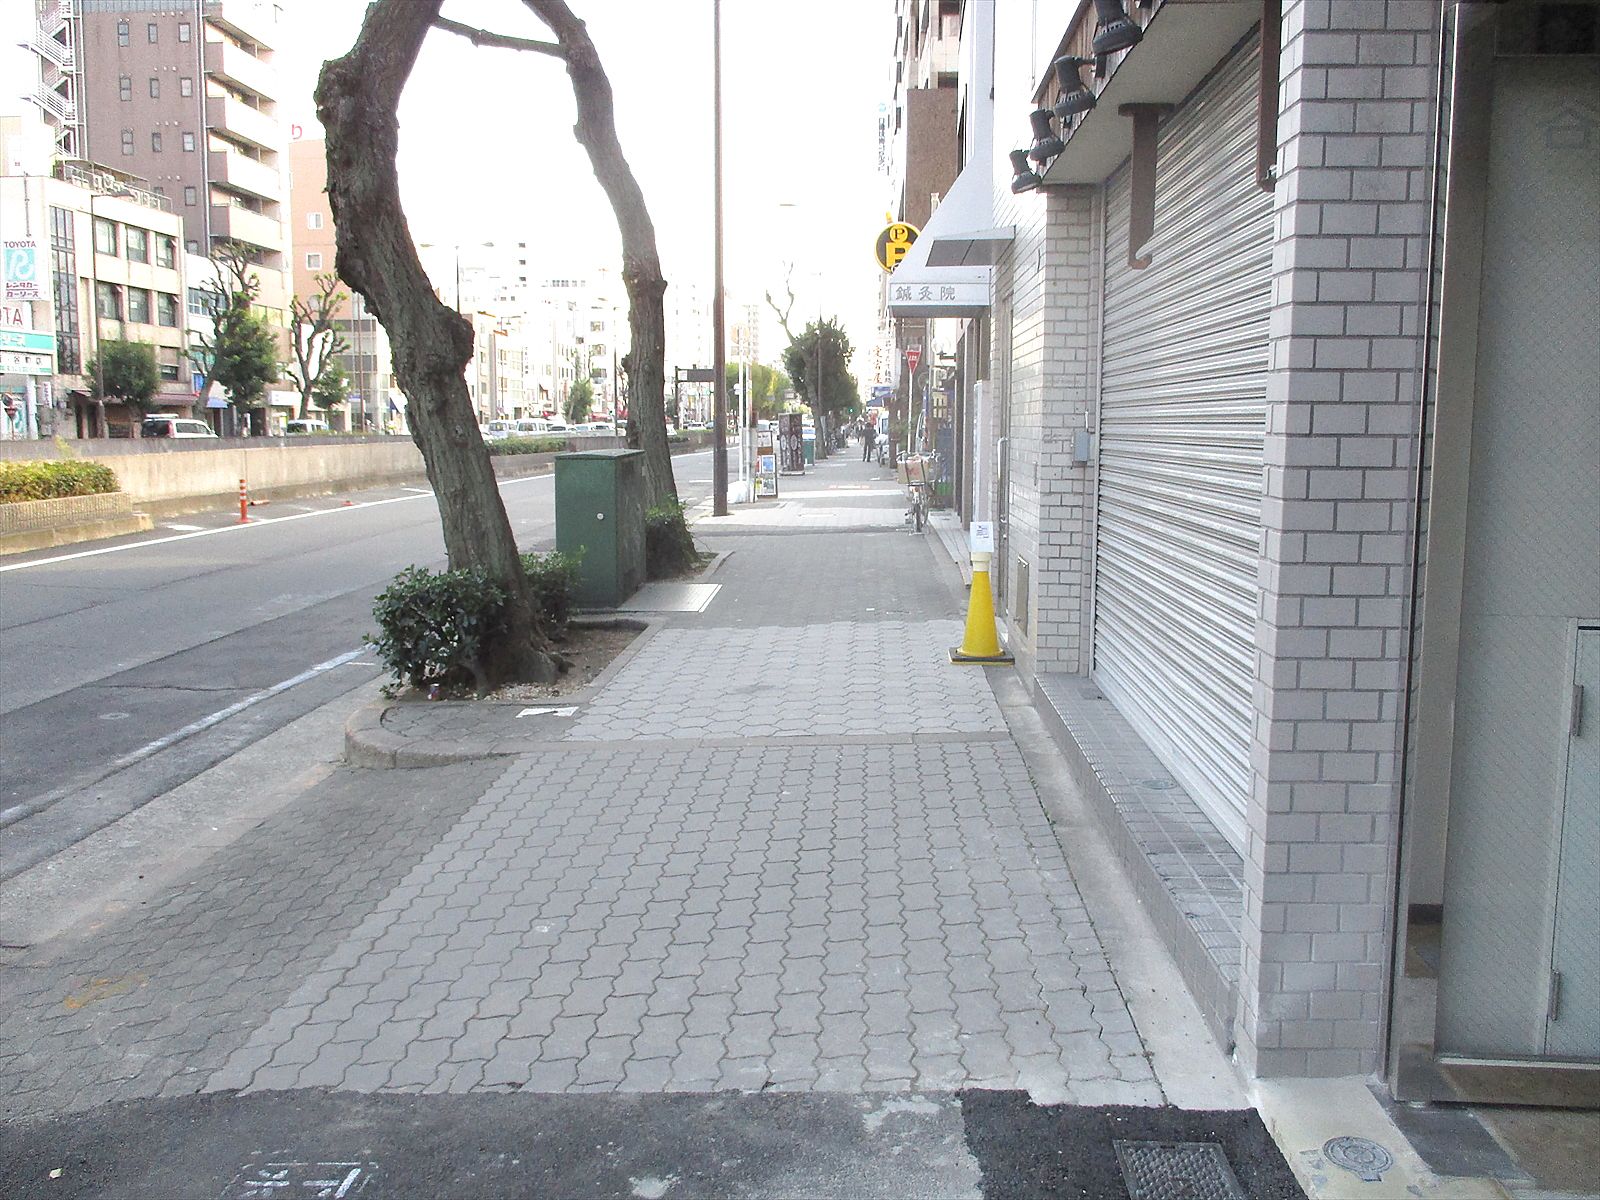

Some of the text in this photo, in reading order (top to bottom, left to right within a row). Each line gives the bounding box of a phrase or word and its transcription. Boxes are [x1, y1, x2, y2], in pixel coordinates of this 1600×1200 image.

[893, 228, 905, 240] P
[895, 286, 956, 301] 鍼灸院
[0, 306, 23, 326] TA
